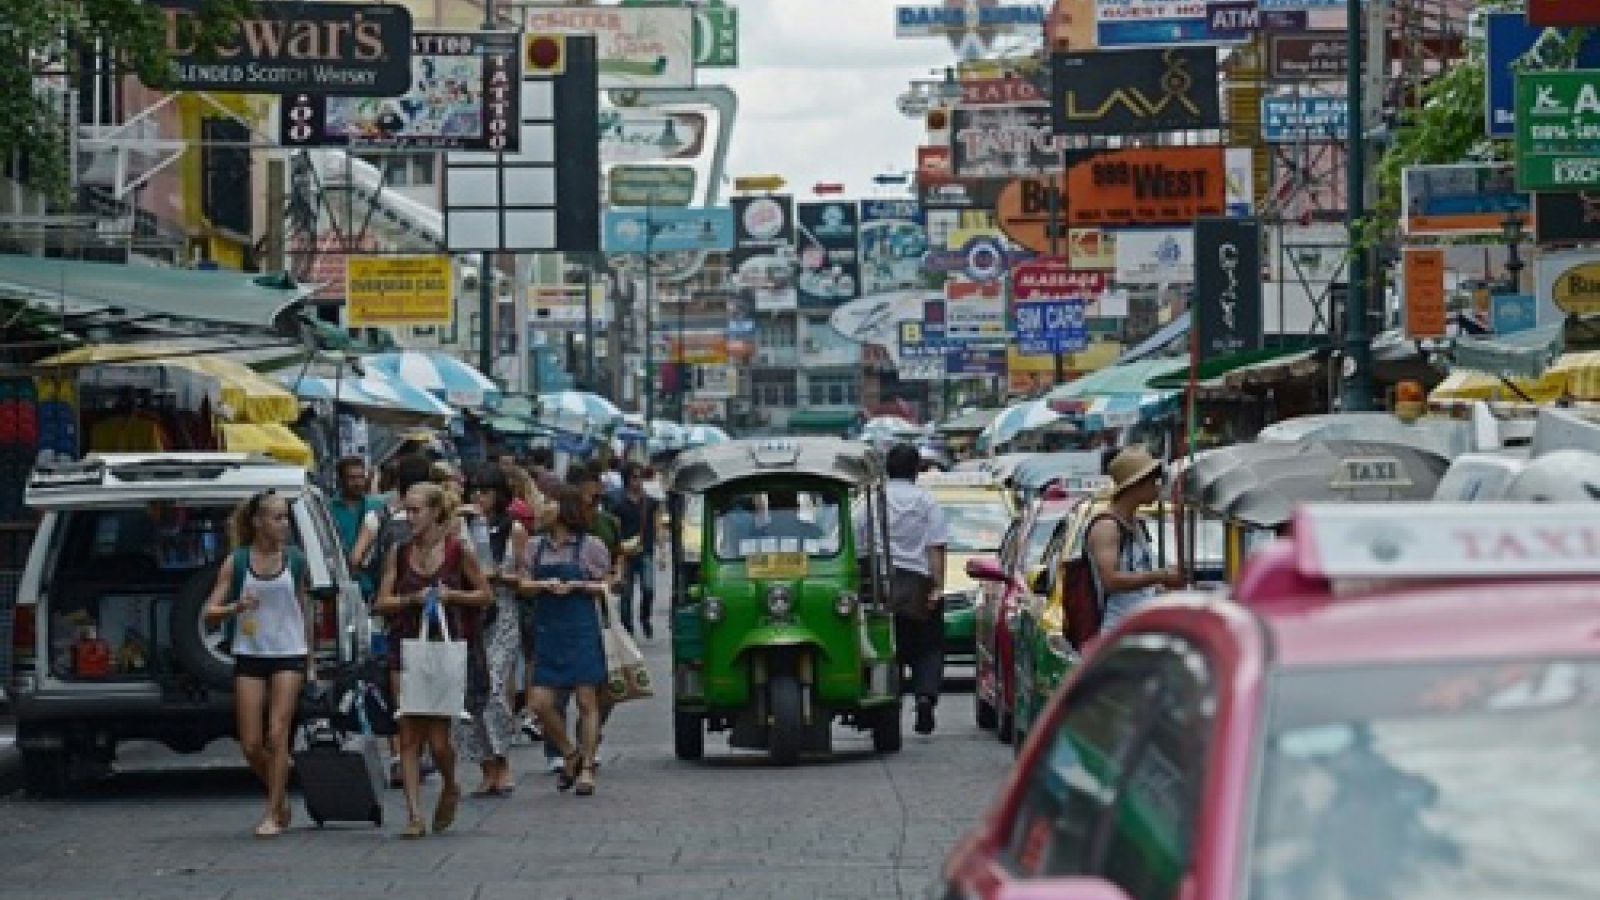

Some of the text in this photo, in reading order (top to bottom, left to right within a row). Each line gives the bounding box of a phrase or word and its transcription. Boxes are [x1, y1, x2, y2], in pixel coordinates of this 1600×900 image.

[1212, 11, 1259, 28] ATM
[489, 56, 508, 149] TATTOO
[1066, 72, 1200, 120] LAVA
[1133, 162, 1207, 199] WEST
[1021, 272, 1098, 287] MASSAGE
[1017, 303, 1084, 331] SIM CARD
[1348, 462, 1397, 481] TAXI
